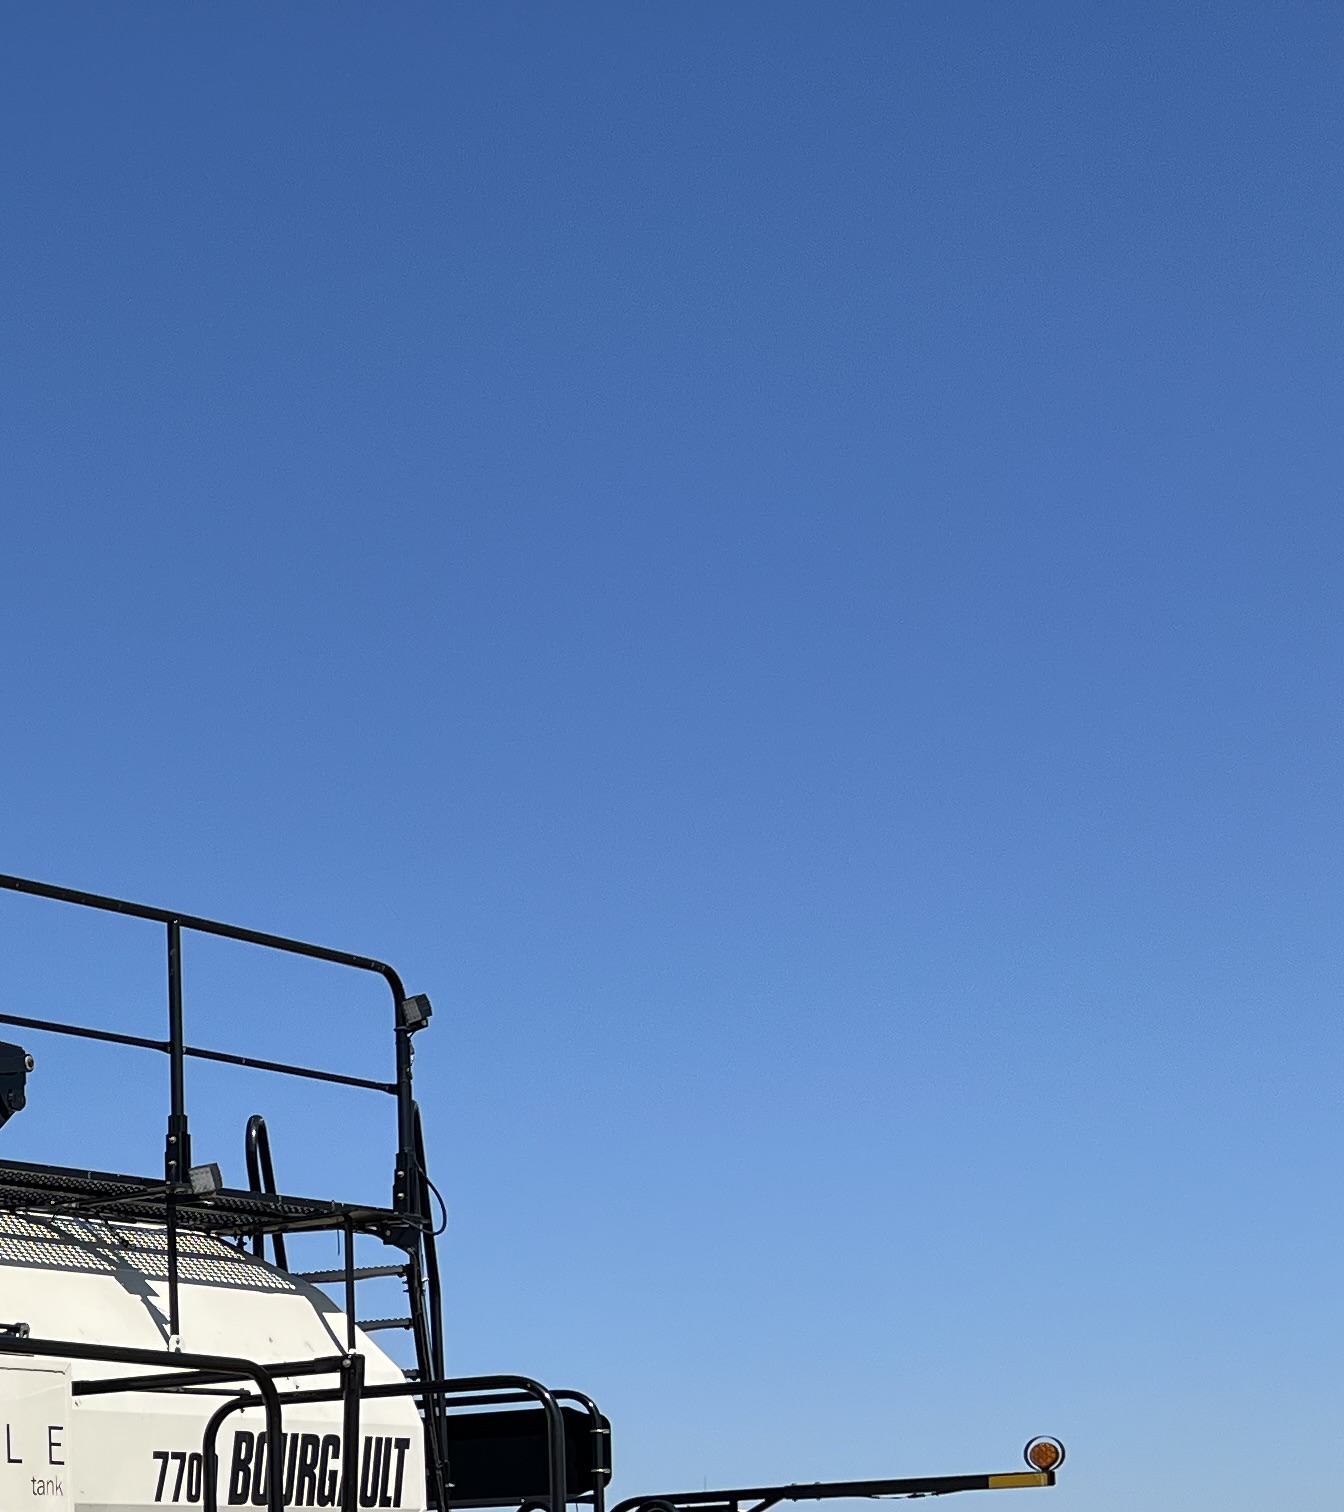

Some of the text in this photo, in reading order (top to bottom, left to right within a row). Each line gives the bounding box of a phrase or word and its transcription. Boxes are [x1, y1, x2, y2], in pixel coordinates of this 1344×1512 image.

[31, 1475, 64, 1497] tank
[152, 1430, 411, 1508] 770 BOURGULT
